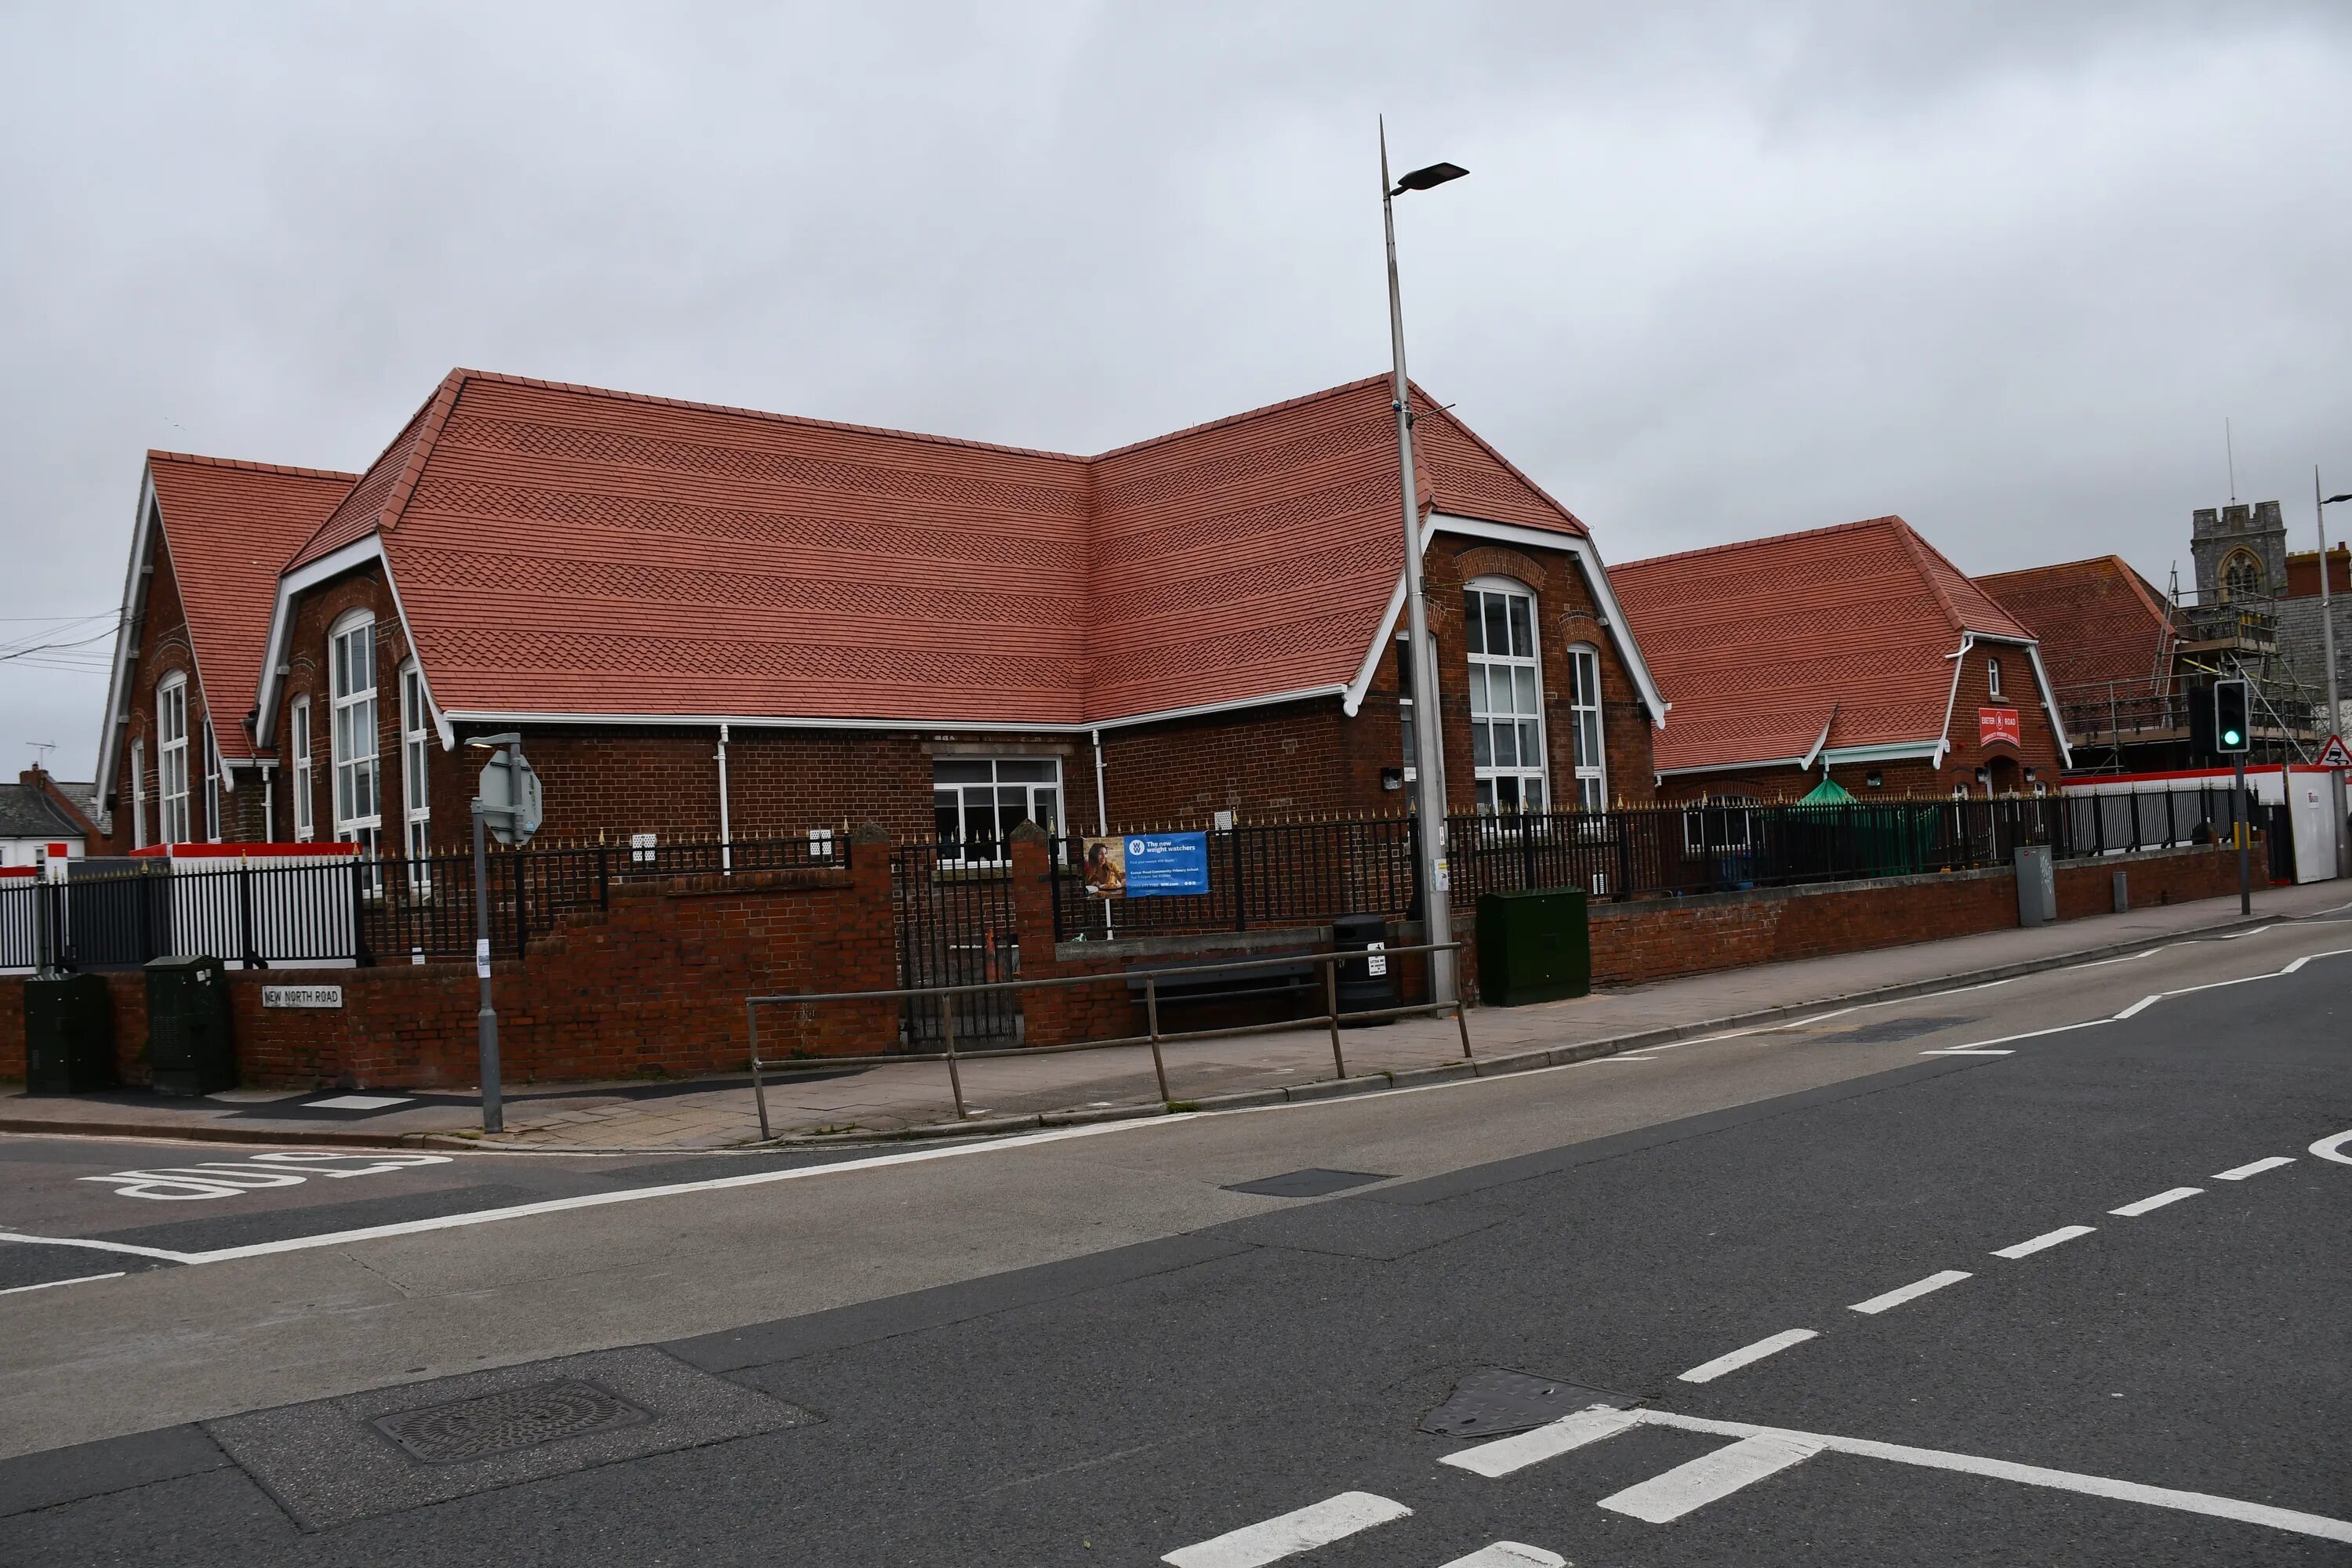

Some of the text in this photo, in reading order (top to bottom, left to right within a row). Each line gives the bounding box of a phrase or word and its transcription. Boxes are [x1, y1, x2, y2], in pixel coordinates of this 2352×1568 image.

[2004, 717, 2016, 726] ROAD
[2008, 734, 2019, 744] SCHOOL
[265, 991, 338, 1002] NEW NORTH ROAD
[76, 1152, 455, 1200] STOP
